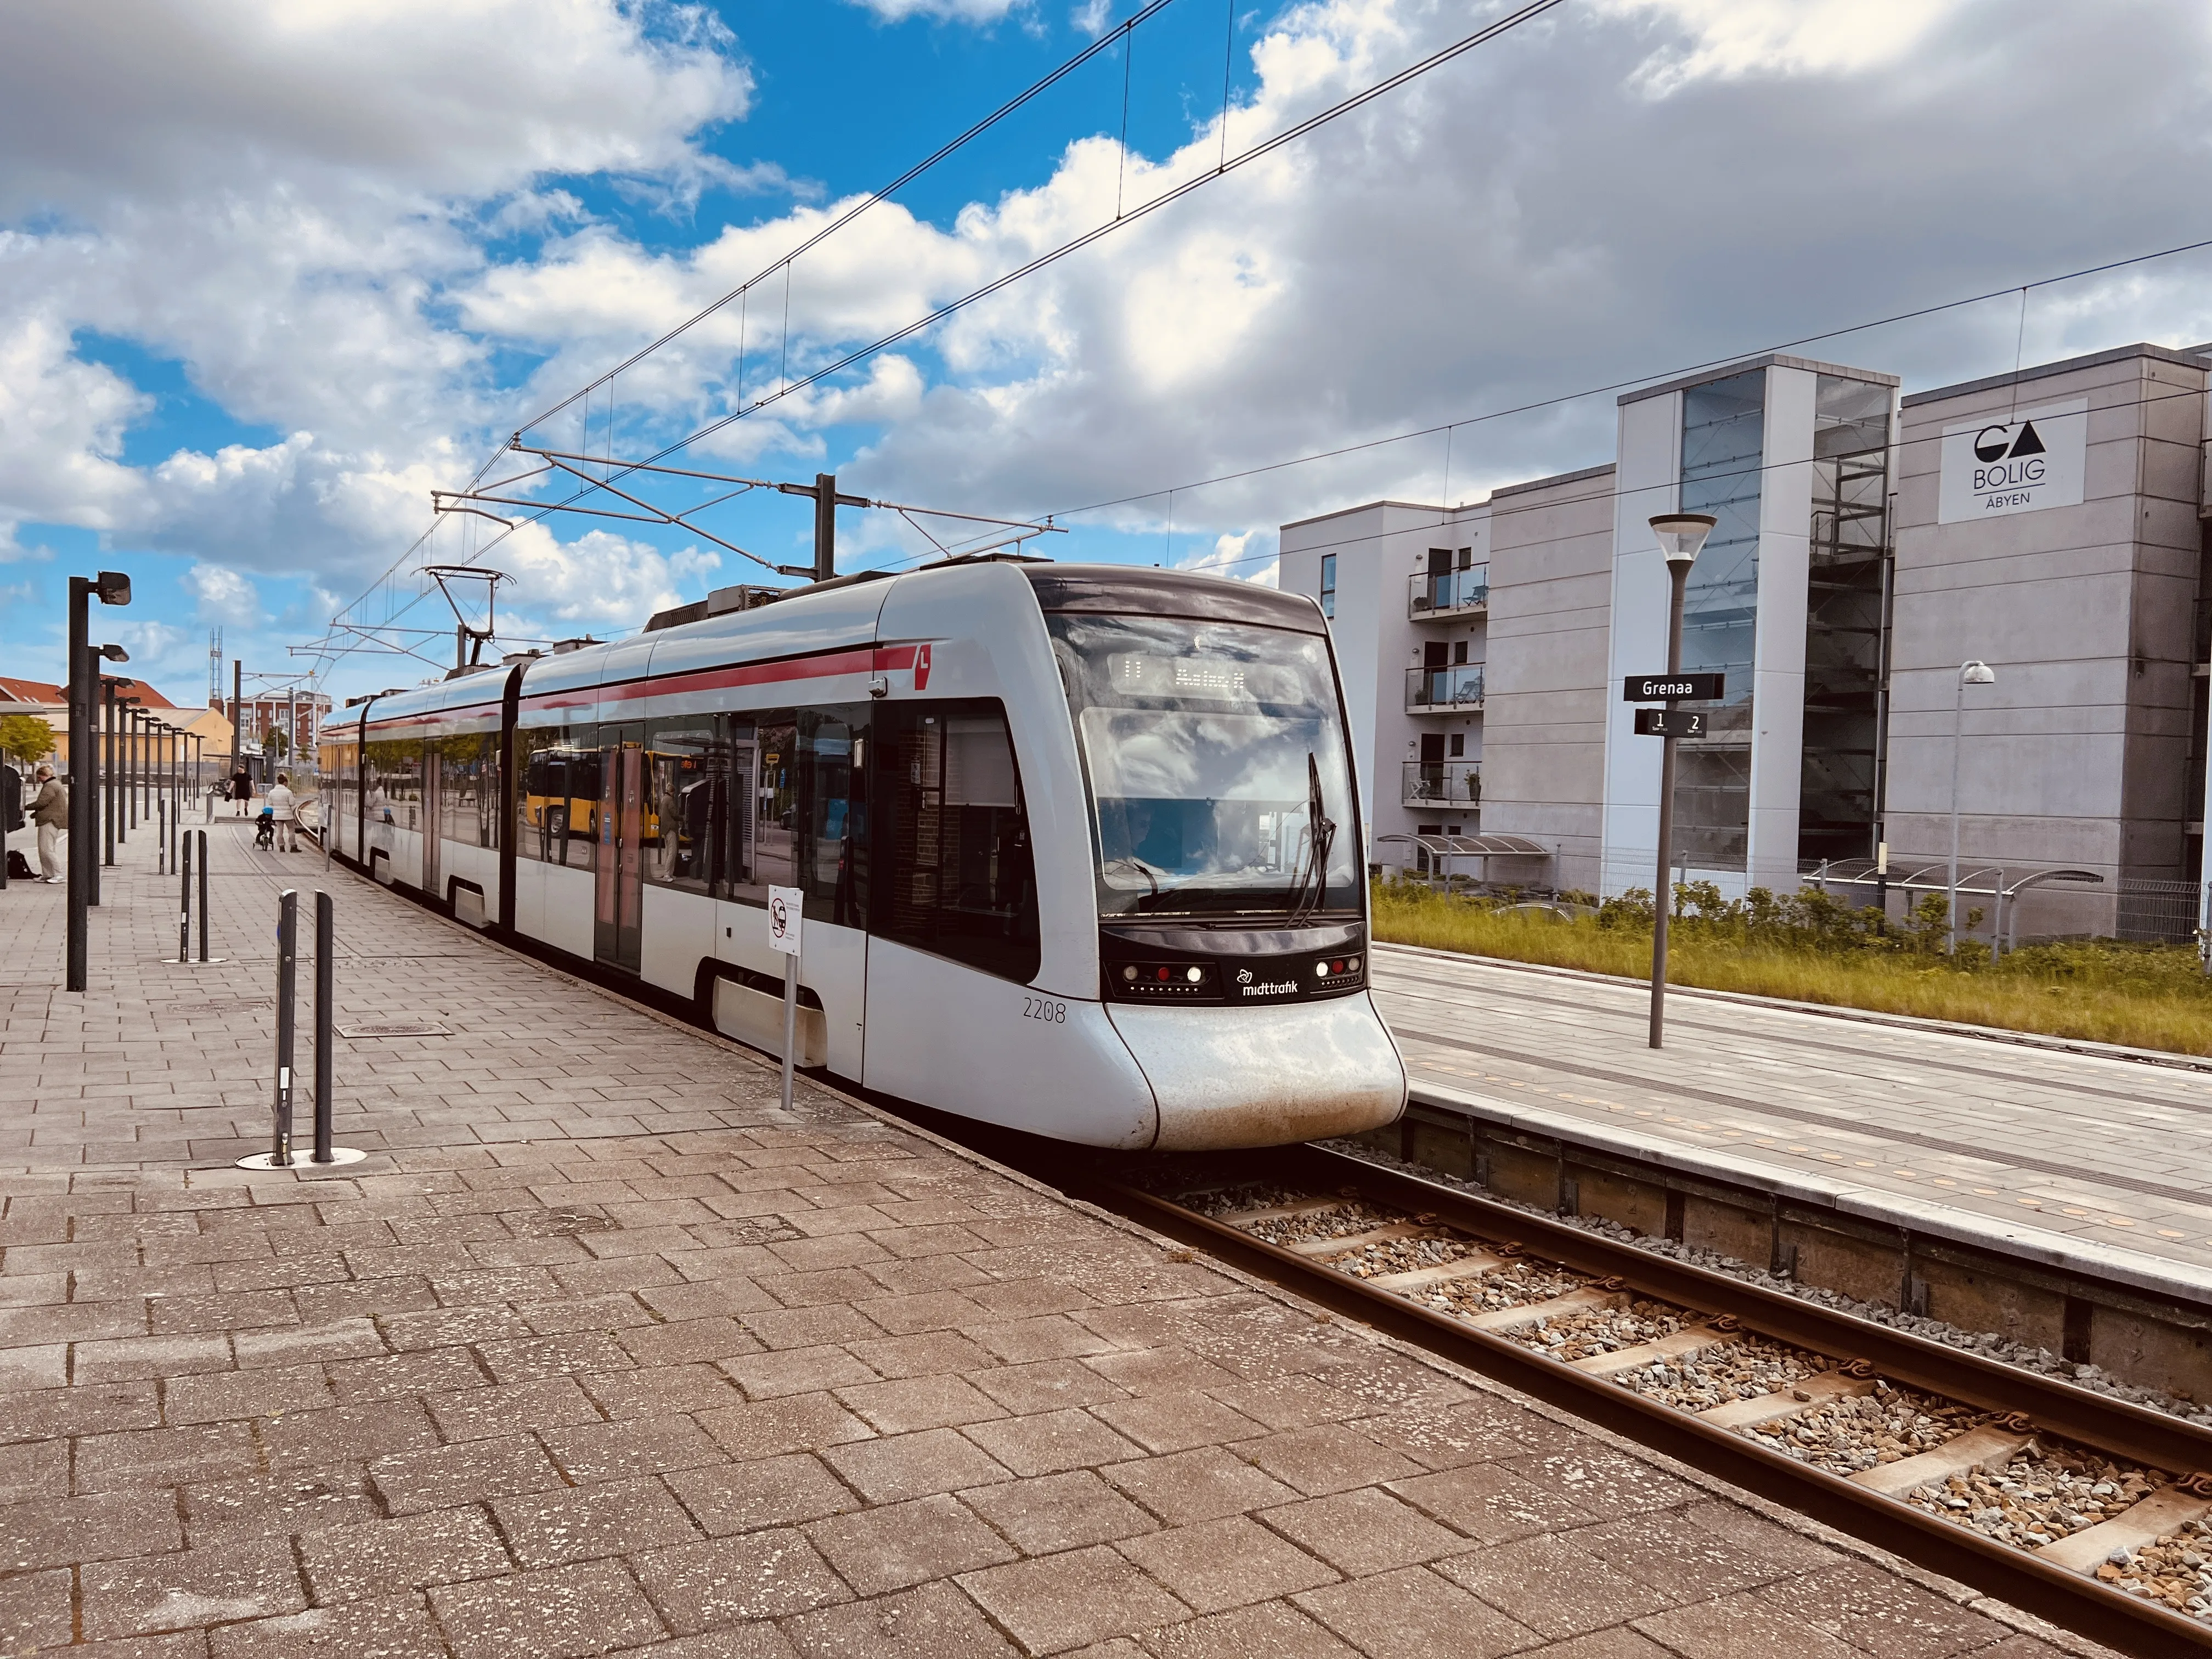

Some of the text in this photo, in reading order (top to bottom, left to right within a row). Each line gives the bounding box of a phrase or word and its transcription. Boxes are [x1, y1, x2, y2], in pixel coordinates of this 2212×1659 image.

[1974, 459, 2045, 490] BOLIG
[1985, 493, 2030, 510] ÅBYEN
[1643, 681, 1693, 695] Grenaa
[1657, 713, 1700, 730] 1 2
[1243, 980, 1298, 996] midttrafik
[1023, 997, 1066, 1024] 2208
